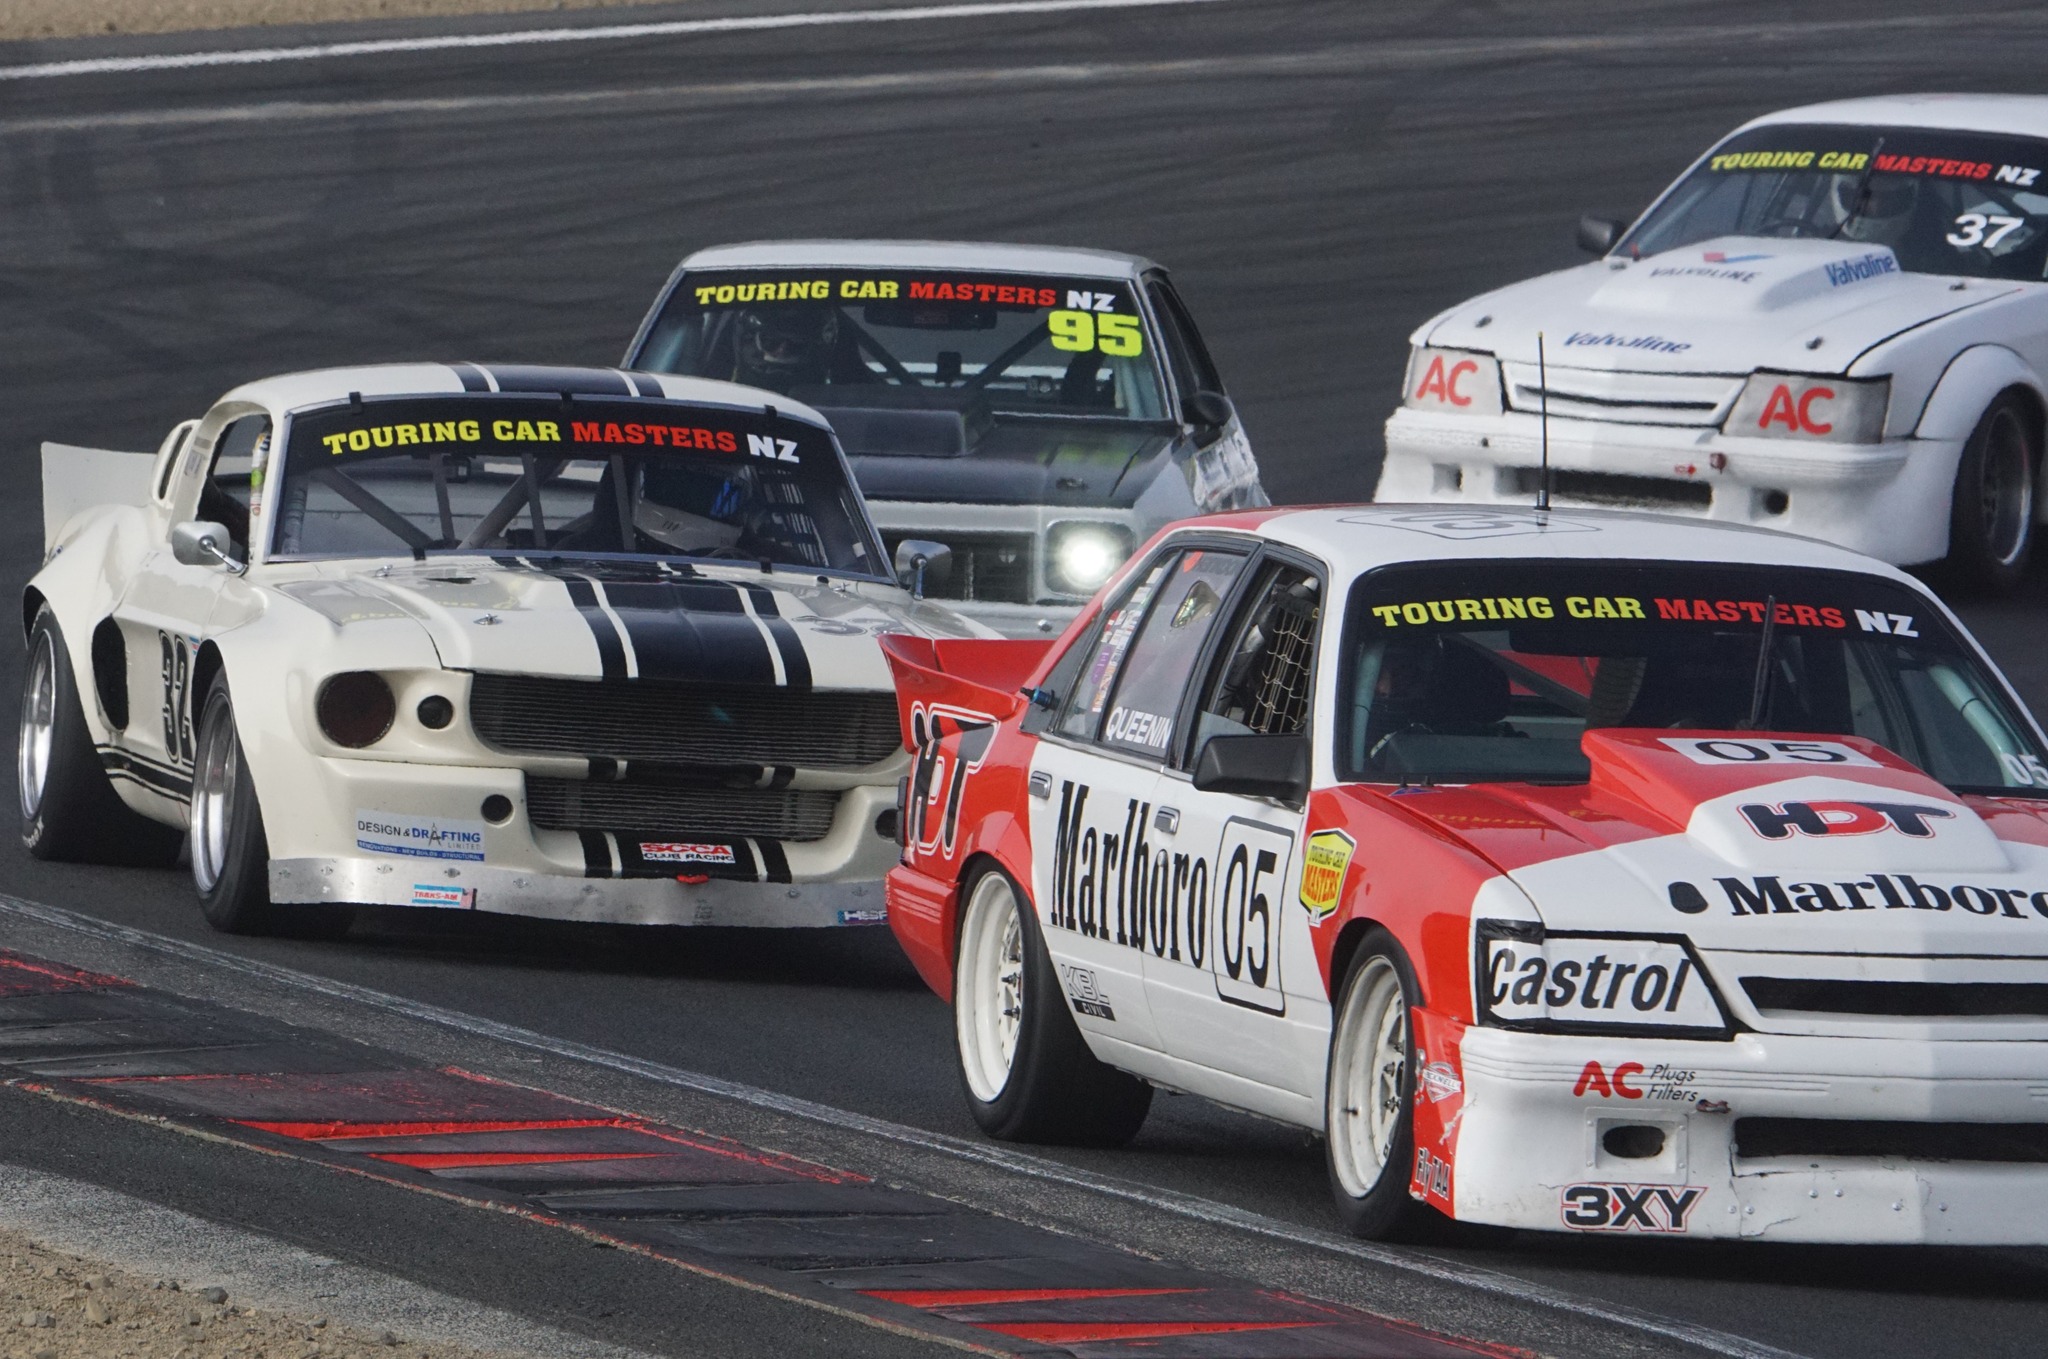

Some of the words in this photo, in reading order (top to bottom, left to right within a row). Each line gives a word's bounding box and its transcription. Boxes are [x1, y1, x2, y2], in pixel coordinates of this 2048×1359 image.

[1710, 151, 1815, 171] TOURING
[1818, 151, 1869, 170] CAR
[1873, 154, 1993, 180] MASTERS
[1995, 164, 2041, 186] NZ
[1946, 213, 2025, 249] 37
[1650, 267, 1761, 283] VALVOLINE
[1824, 251, 1896, 287] Valvoline
[695, 280, 830, 305] TOURING
[840, 280, 899, 299] CAR
[909, 281, 1057, 307] MASTERS
[1066, 289, 1116, 312] NZ
[1048, 310, 1143, 358] 95
[1563, 331, 1692, 354] Valvoline
[1415, 355, 1479, 407] AC
[1758, 384, 1836, 436] AC
[322, 420, 481, 455] TOURING
[492, 420, 561, 442] CAR
[571, 421, 738, 453] MASTERS
[746, 433, 800, 464] NZ
[1371, 597, 1555, 627] TOURING
[1565, 596, 1646, 619] CAR
[1654, 598, 1847, 629] MASTERS
[1854, 609, 1919, 638] NZ
[1694, 740, 1849, 763] 05
[357, 820, 401, 836] DESIGN
[412, 825, 481, 846] DRAFTING
[1737, 799, 1957, 841] HDT
[448, 842, 480, 850] LIMITED
[642, 842, 732, 855] SCCA
[686, 853, 734, 862] RACING
[1050, 779, 1208, 970] Marlboro
[414, 890, 459, 901] TRANS-AM
[1222, 843, 1278, 989] 05
[1061, 963, 1111, 1006] KBL
[1490, 948, 1691, 1012] Castrol
[1082, 1002, 1107, 1018] CIVIL
[1573, 1060, 1645, 1099] AC
[1650, 1063, 1696, 1086] Plugs
[1646, 1082, 1699, 1102] Filters
[1563, 1184, 1705, 1232] 3XY
